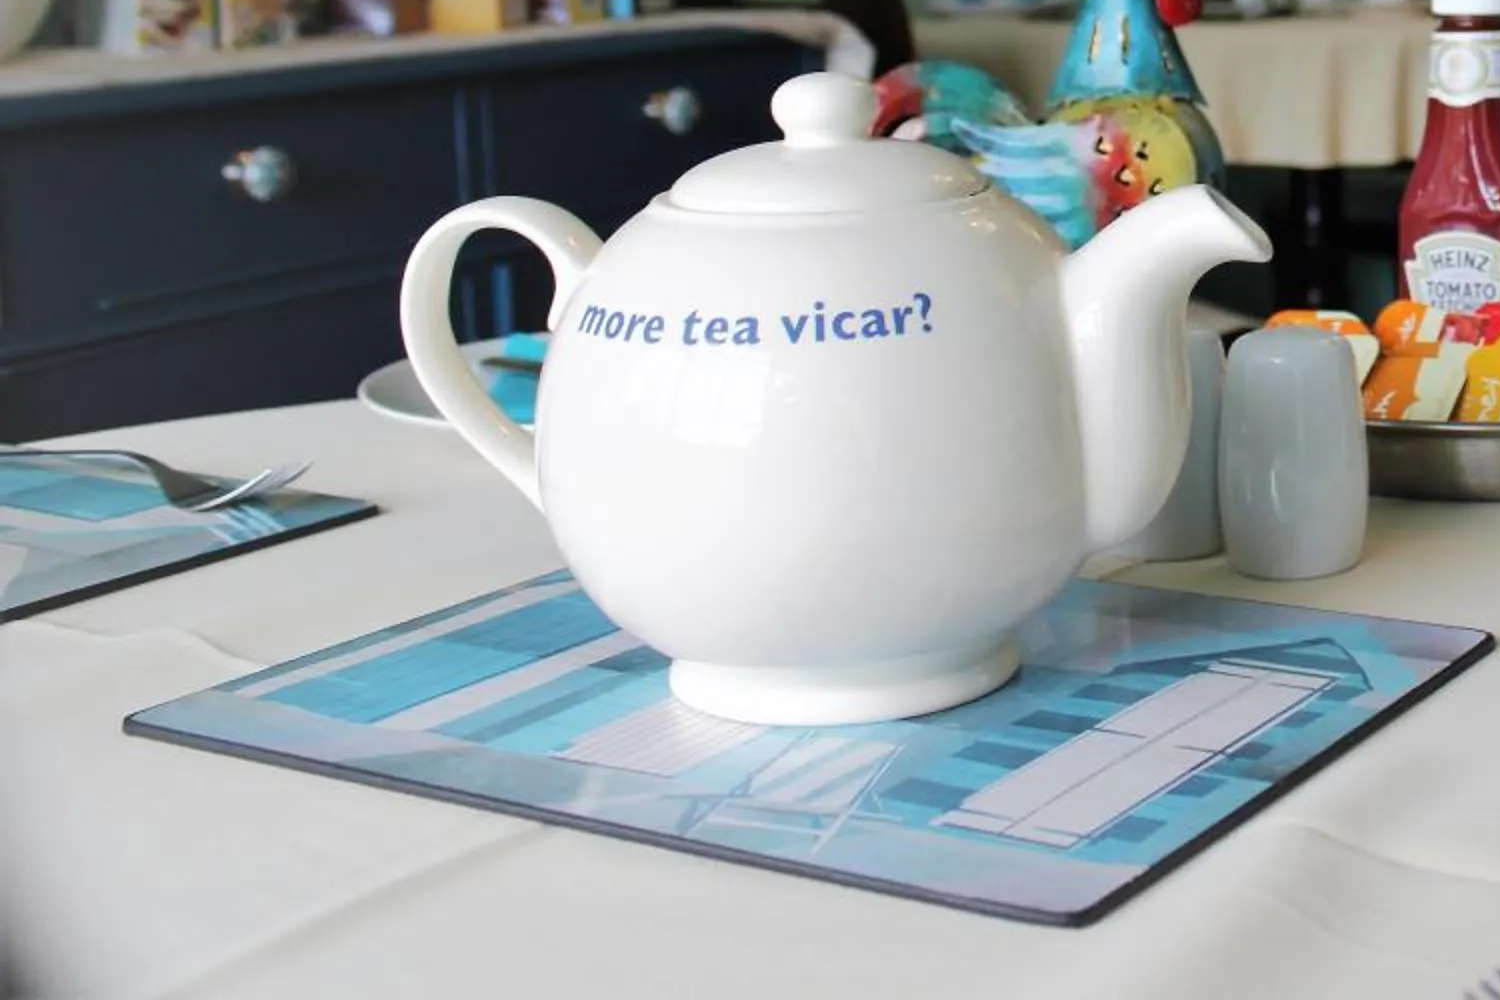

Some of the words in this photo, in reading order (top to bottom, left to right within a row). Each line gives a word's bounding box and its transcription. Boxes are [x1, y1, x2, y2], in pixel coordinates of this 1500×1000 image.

[1430, 250, 1490, 273] HEINZ
[1426, 280, 1497, 300] TOMATO
[577, 302, 665, 346] more
[681, 308, 760, 346] tea
[780, 292, 933, 344] vicar?
